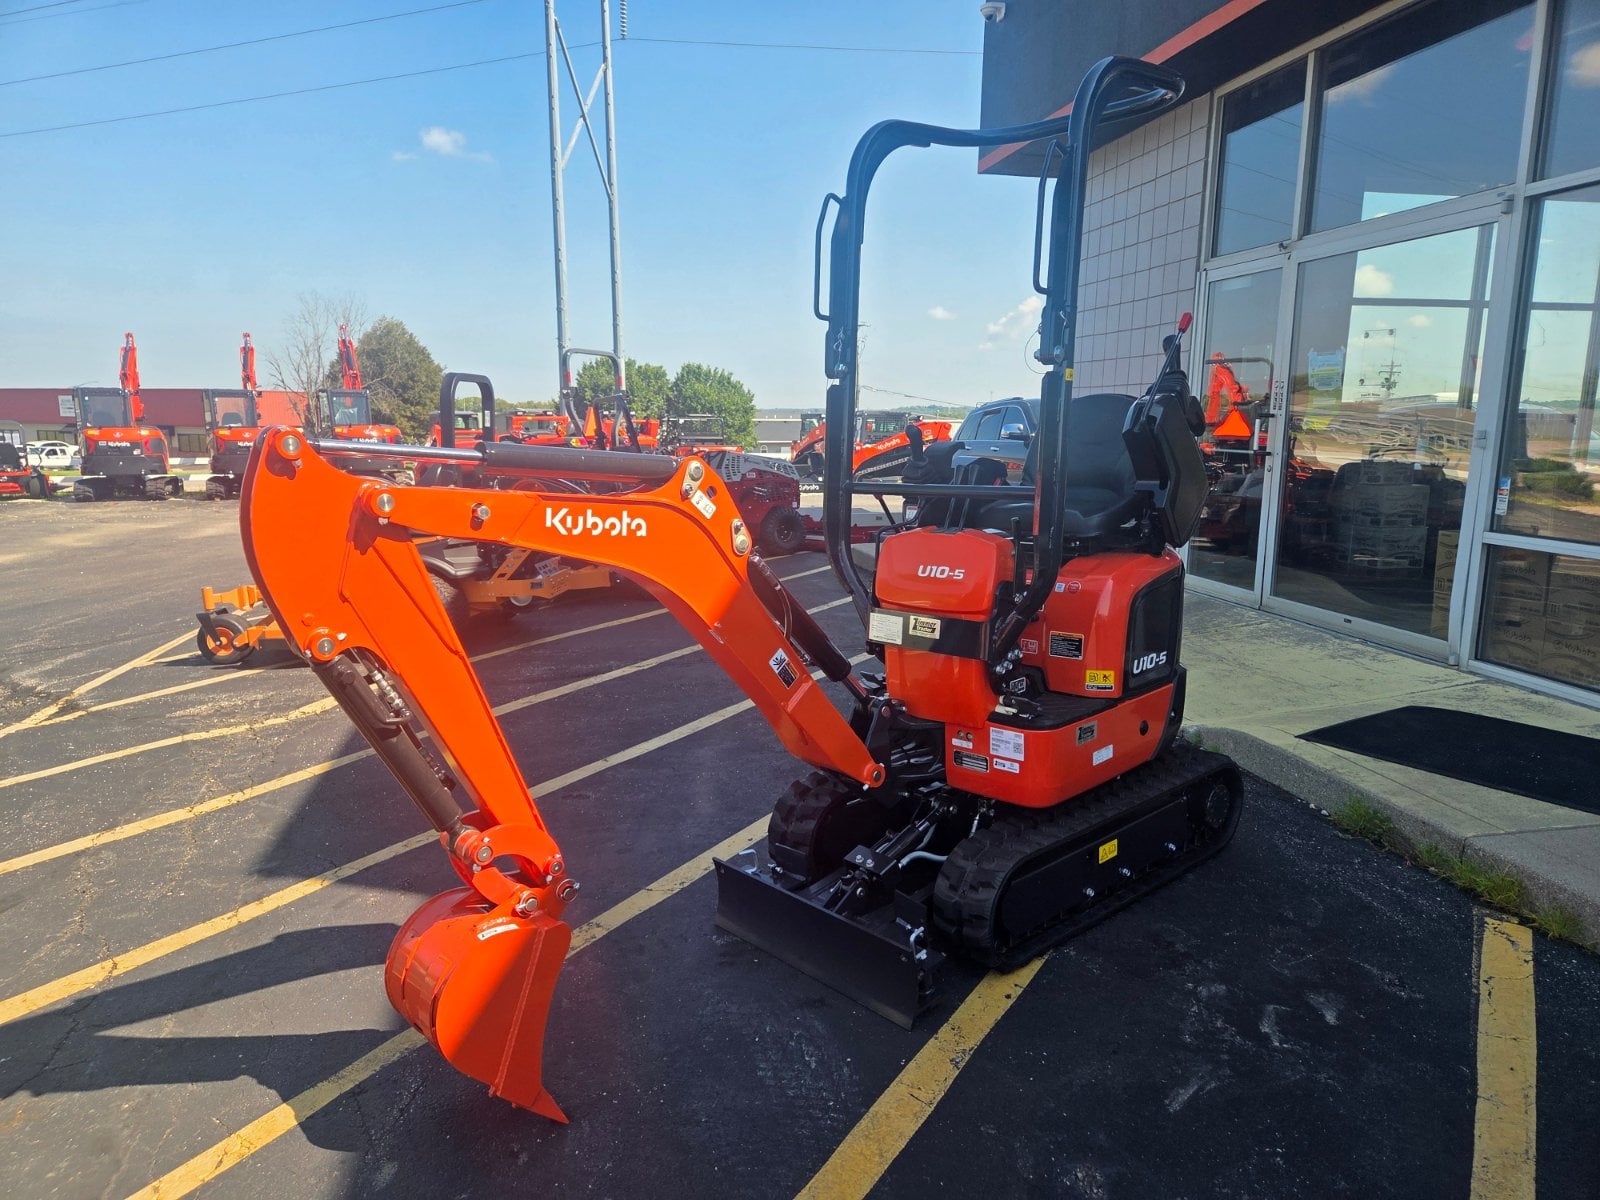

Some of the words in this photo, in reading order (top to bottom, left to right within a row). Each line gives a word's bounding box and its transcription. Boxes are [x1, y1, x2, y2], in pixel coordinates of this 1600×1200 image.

[545, 507, 647, 537] Kubota
[917, 564, 965, 580] U10-5
[1133, 650, 1168, 675] U10-5
